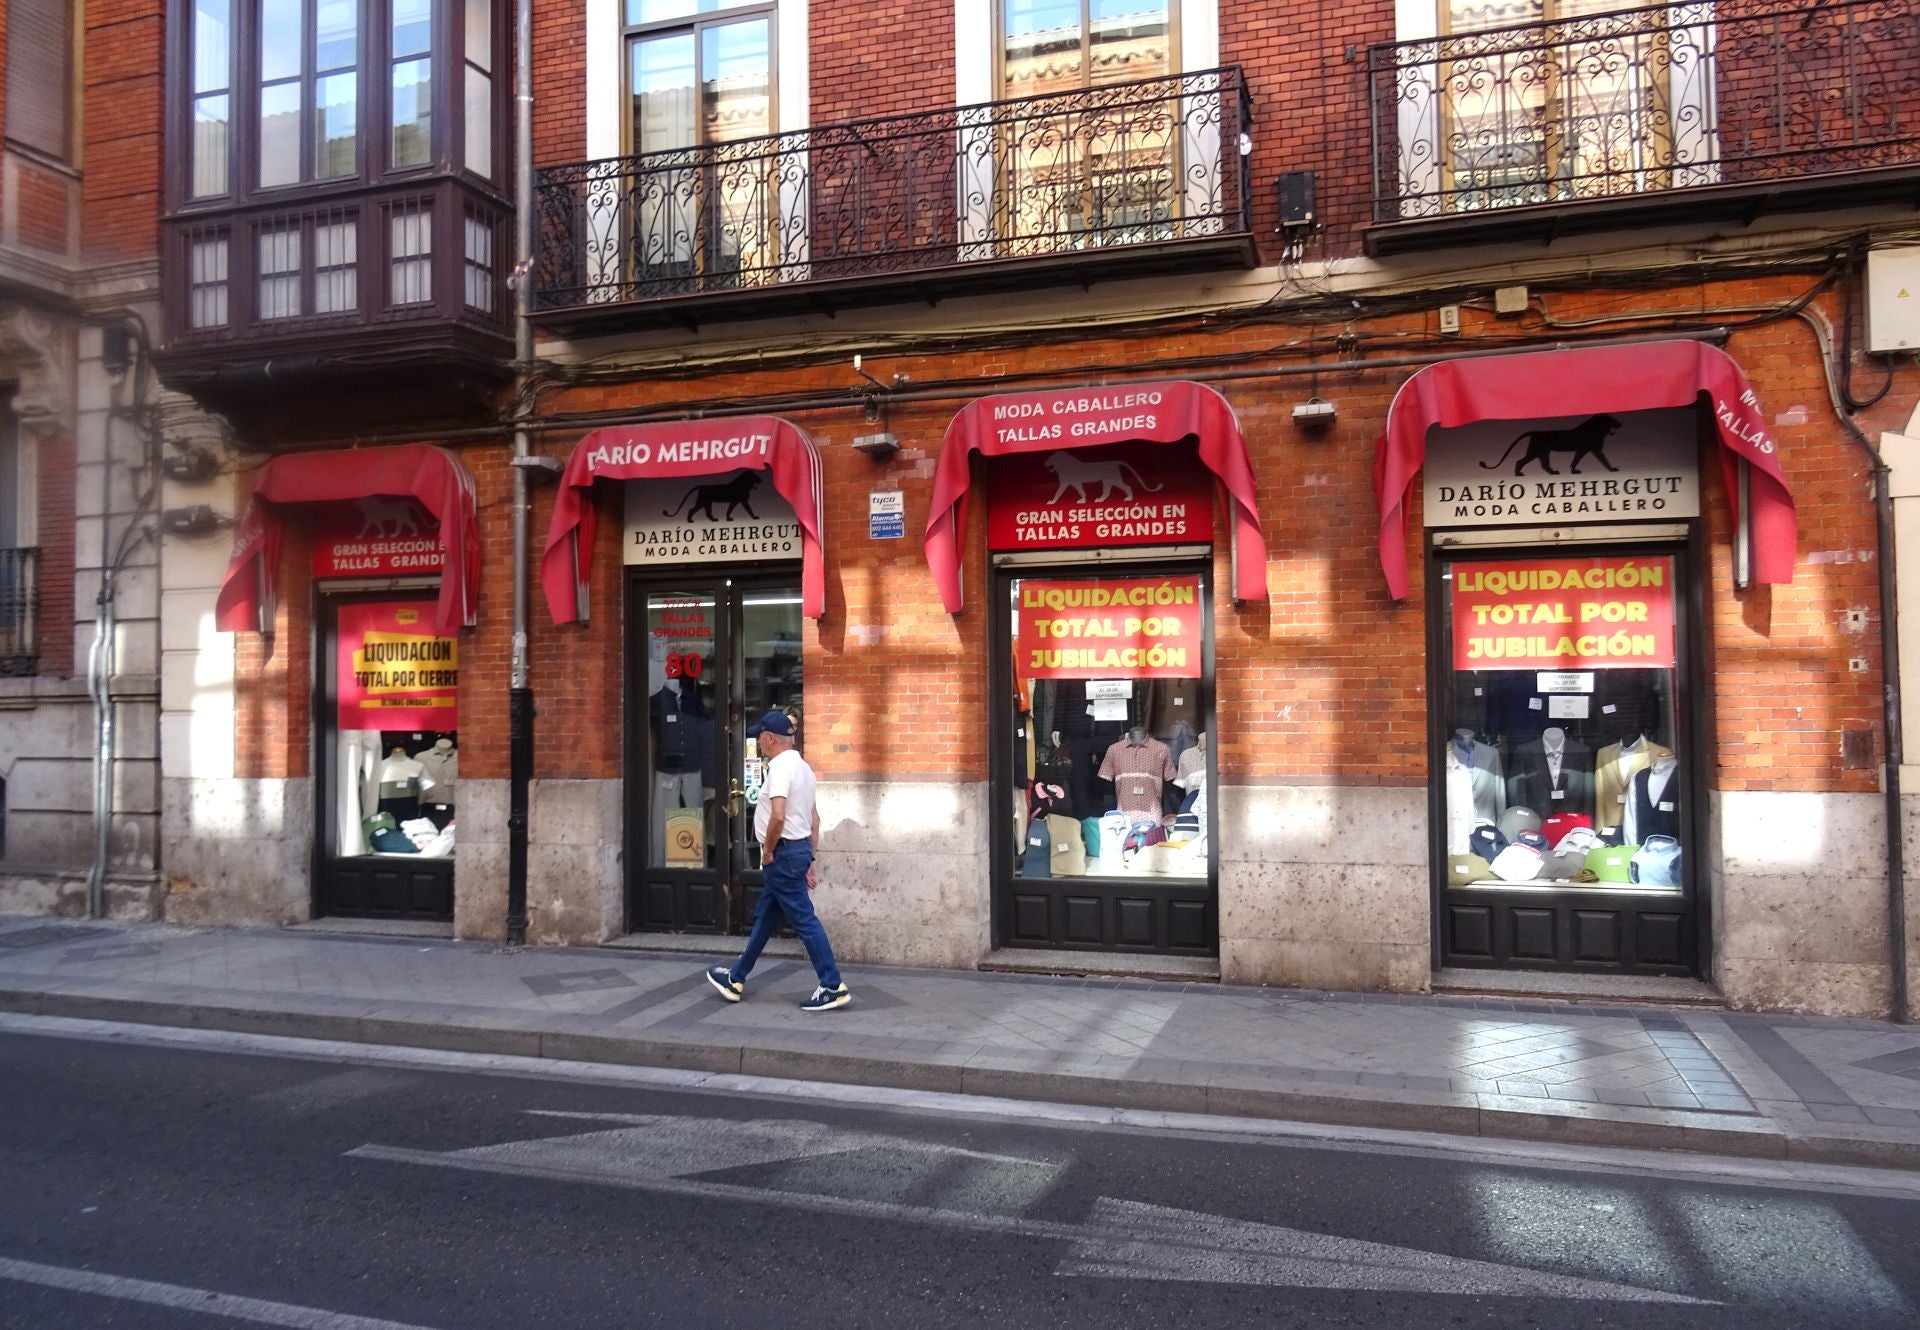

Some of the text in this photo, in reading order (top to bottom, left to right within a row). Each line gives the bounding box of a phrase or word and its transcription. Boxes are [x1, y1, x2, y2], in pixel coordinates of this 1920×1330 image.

[994, 392, 1163, 420] MODA CABALLERO
[997, 415, 1157, 443] TALLAS GRANDES
[1716, 399, 1775, 455] TALLAS
[656, 434, 773, 464] MEHRGUT
[872, 496, 896, 505] tyco
[1439, 475, 1683, 503] DARÍO MEHRGUT
[1016, 502, 1186, 526] GRAN SELECCIÓN EN
[1454, 497, 1667, 518] MODA CABALLERO
[634, 523, 802, 546] DARÍO MEHRGUT
[1016, 520, 1187, 541] TALLAS GRANDES
[333, 544, 368, 556] GRAN
[371, 539, 435, 555] SELECCIÓN
[645, 541, 793, 557] MODA CABALLERO
[333, 557, 380, 570] TALLAS
[1458, 562, 1663, 596] LIQUIDACIÓN
[1023, 581, 1194, 611] LIQUIDACIÓN
[660, 612, 705, 624] TALLAS
[1472, 601, 1648, 625] TOTAL POR
[653, 626, 712, 638] GRANDES
[1035, 617, 1181, 638] TOTAL POR
[363, 635, 452, 665] LIQUIDACIÓN
[1030, 642, 1187, 669] JUBILACIÓN
[1467, 629, 1656, 659] JUBILACIÓN
[665, 650, 703, 679] 80
[355, 671, 390, 688] TOTAL
[392, 670, 416, 687] POR
